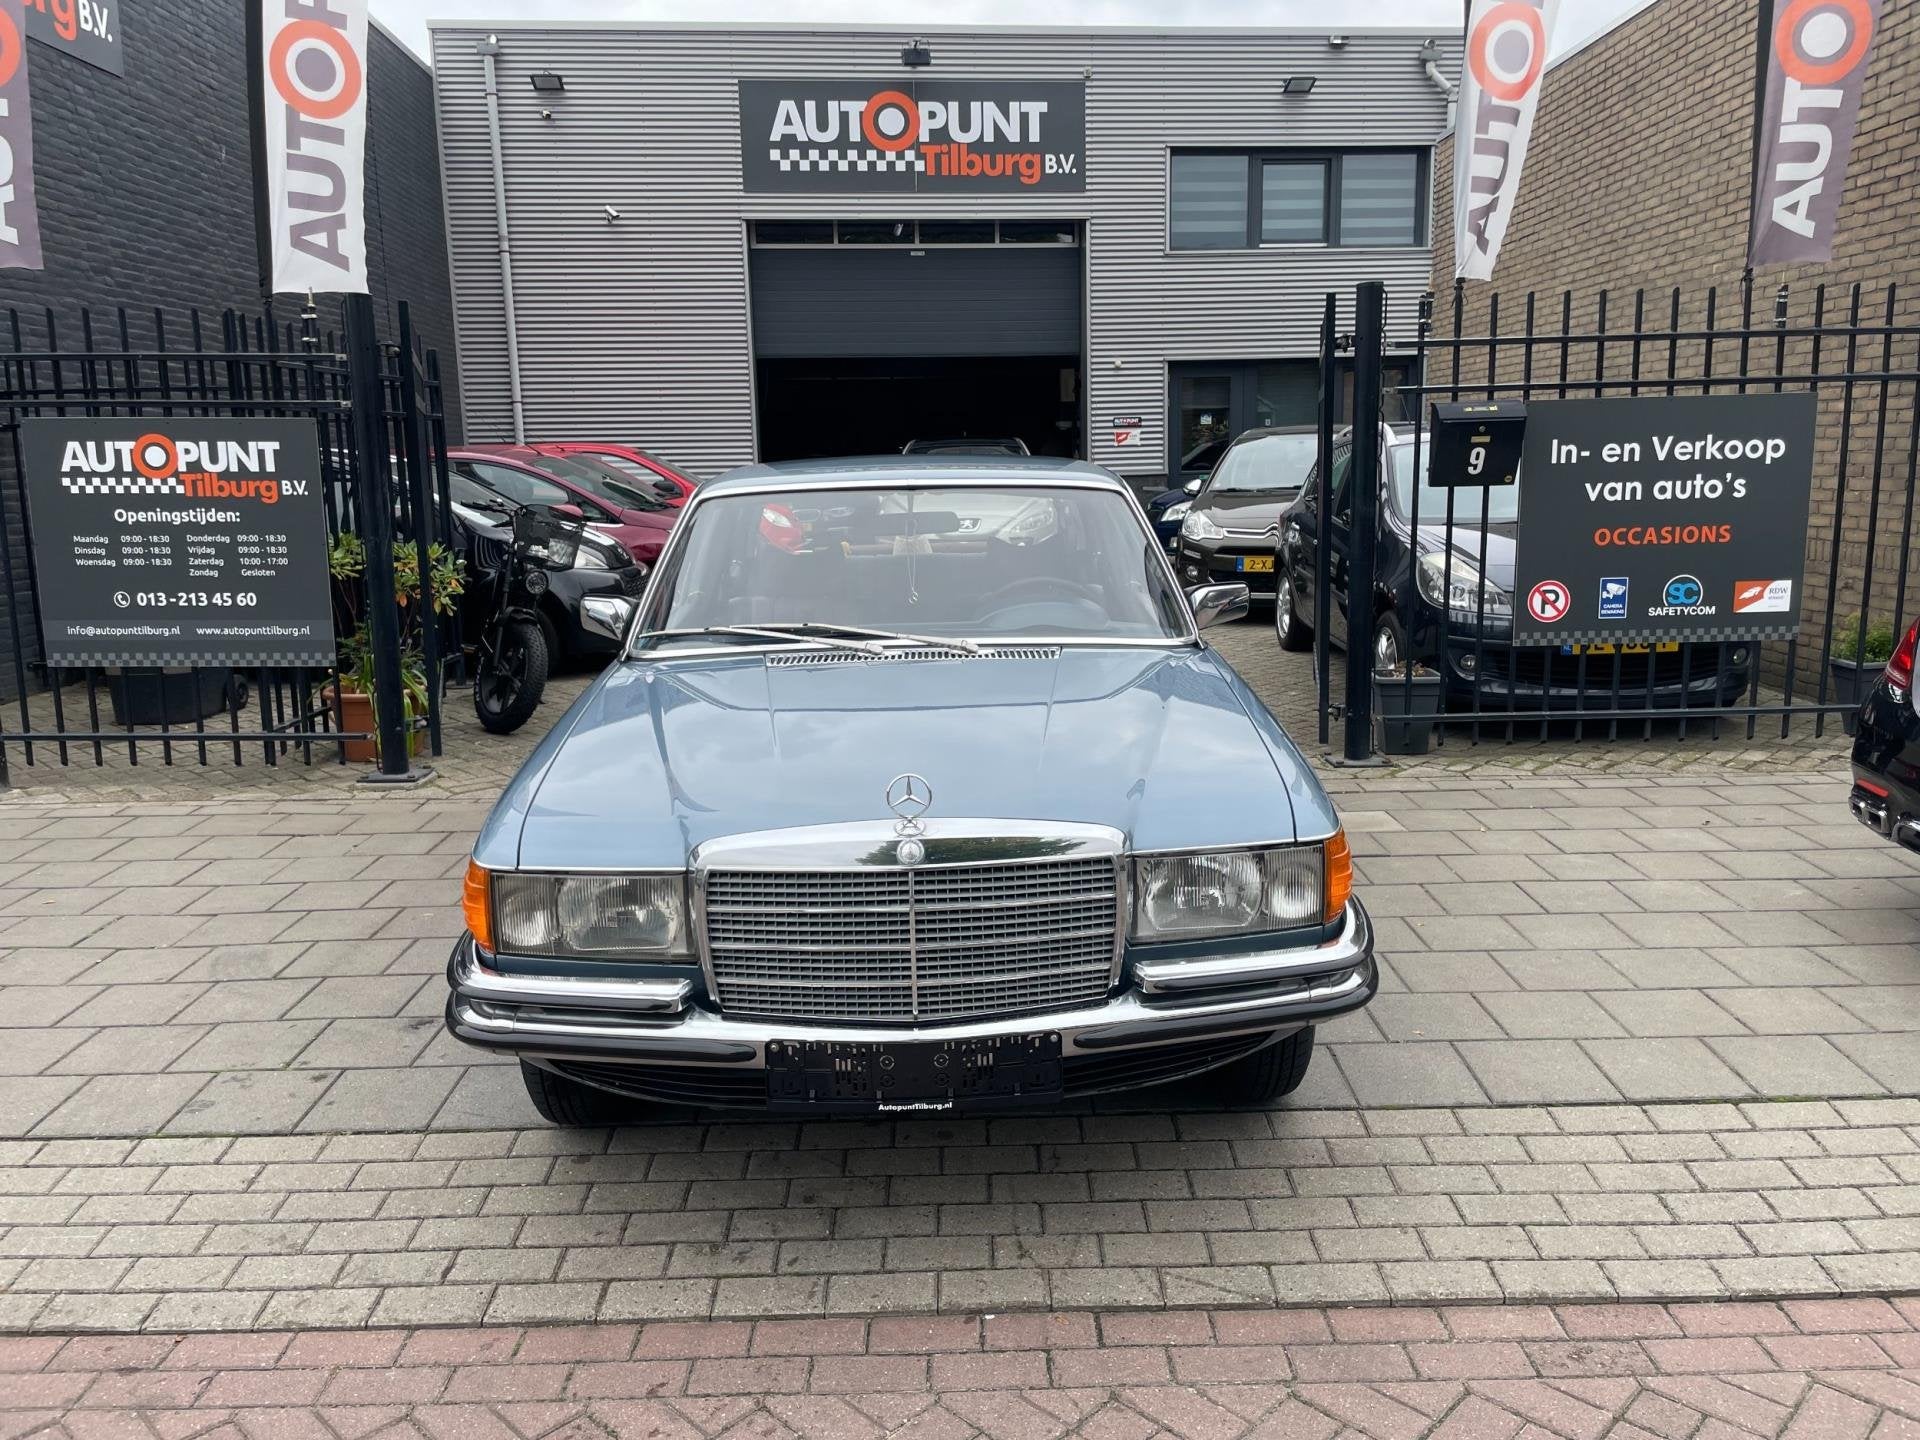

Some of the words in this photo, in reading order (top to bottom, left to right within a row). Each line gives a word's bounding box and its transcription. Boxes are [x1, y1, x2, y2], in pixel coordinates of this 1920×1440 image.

[78, 0, 112, 42] B.V.
[769, 90, 1048, 153] AUTOPUNT
[919, 144, 1041, 185] Tilburg
[1044, 153, 1077, 174] B.V.
[1551, 438, 1591, 464] In-
[1601, 442, 1641, 462] en
[1652, 434, 1786, 464] Verkoop
[61, 433, 280, 479] AUTOPUNT
[1467, 446, 1486, 475] 9
[179, 472, 279, 504] Tilburg
[281, 480, 309, 496] B.V.
[1584, 481, 1643, 502] van
[1652, 472, 1747, 500] auto's
[113, 507, 241, 525] Openingstijden:
[73, 535, 109, 544] Maandag
[186, 534, 231, 543] Donderdag
[237, 534, 259, 542] 09:00
[264, 534, 287, 542] 18:30
[1593, 524, 1732, 546] OCCASIONS
[74, 546, 106, 555] Dinsdag
[187, 545, 216, 555] Vrijdag
[238, 546, 260, 554] 09:00
[265, 546, 288, 554] 18:30
[75, 558, 117, 567] Woensdag
[151, 558, 172, 566] 18:30
[188, 557, 224, 567] Zaterdag
[188, 568, 219, 577] Zondag
[241, 568, 276, 577] Gesloten
[211, 592, 233, 606] 45
[236, 592, 257, 607] 60
[1647, 606, 1716, 616] SAFETYCOM
[67, 625, 180, 637] info@autopunttilburg.nl
[195, 625, 311, 637] www.autopunttilburg.nl
[878, 1101, 953, 1112] AutopuntTilburg.nl
